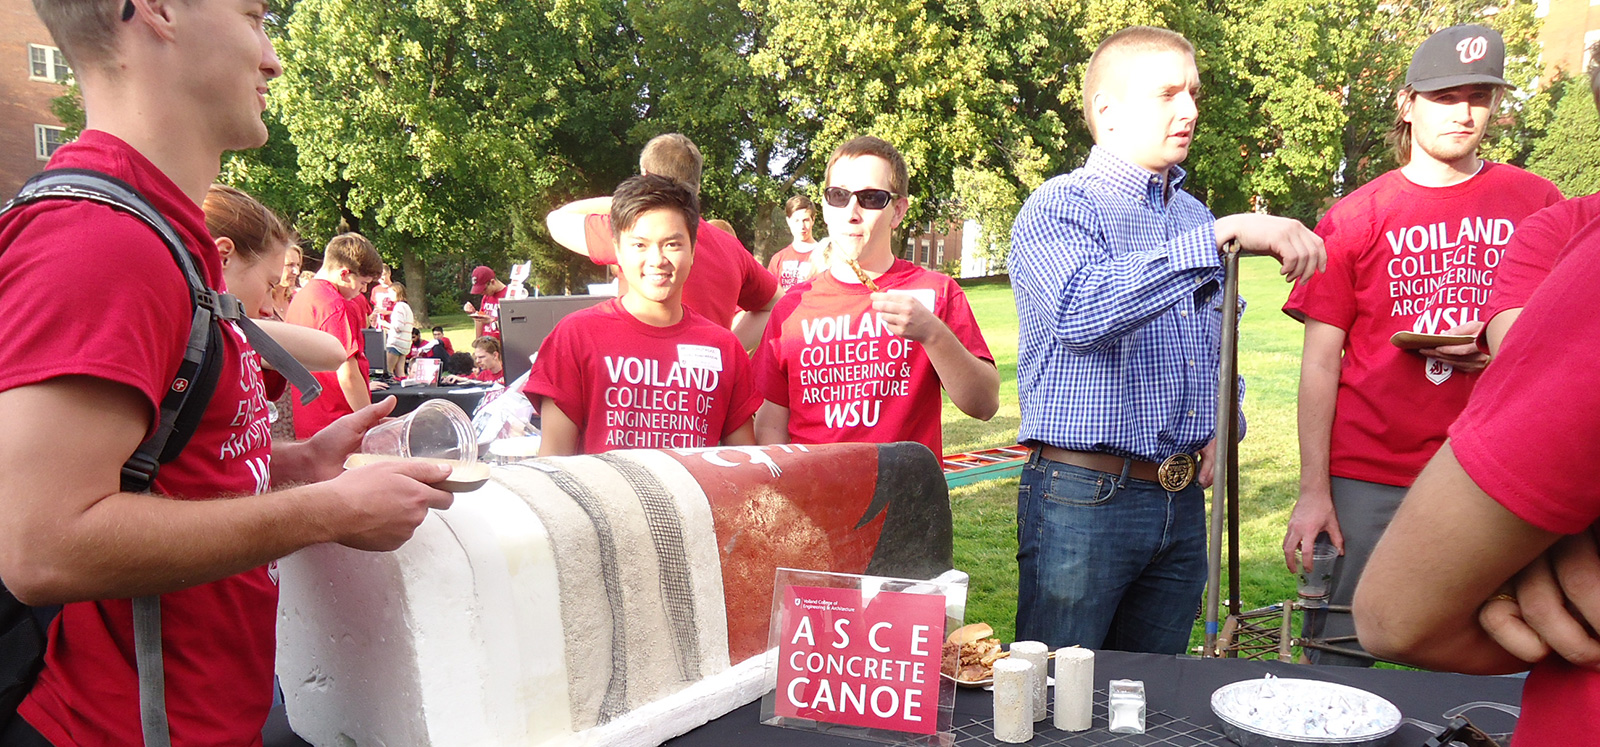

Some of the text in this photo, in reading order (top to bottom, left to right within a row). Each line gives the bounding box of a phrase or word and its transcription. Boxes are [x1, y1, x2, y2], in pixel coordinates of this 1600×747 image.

[1385, 216, 1514, 255] VOILAND
[1387, 245, 1506, 279] COLLEGE O
[1389, 267, 1493, 298] ENGINEERING
[1391, 286, 1493, 317] ARCHITECTU
[801, 312, 894, 345] VOILAN
[800, 339, 914, 367] COLLEGE OF
[604, 356, 719, 392] VOILAND
[800, 361, 911, 385] ENGINEERING &
[605, 386, 714, 416] COLLEGE OF
[802, 380, 909, 404] ARCHITECTURE
[606, 410, 701, 432] ENGINEERING
[824, 400, 881, 429] WSU
[790, 650, 925, 684] CONCRETE
[786, 677, 923, 722] CANOE
